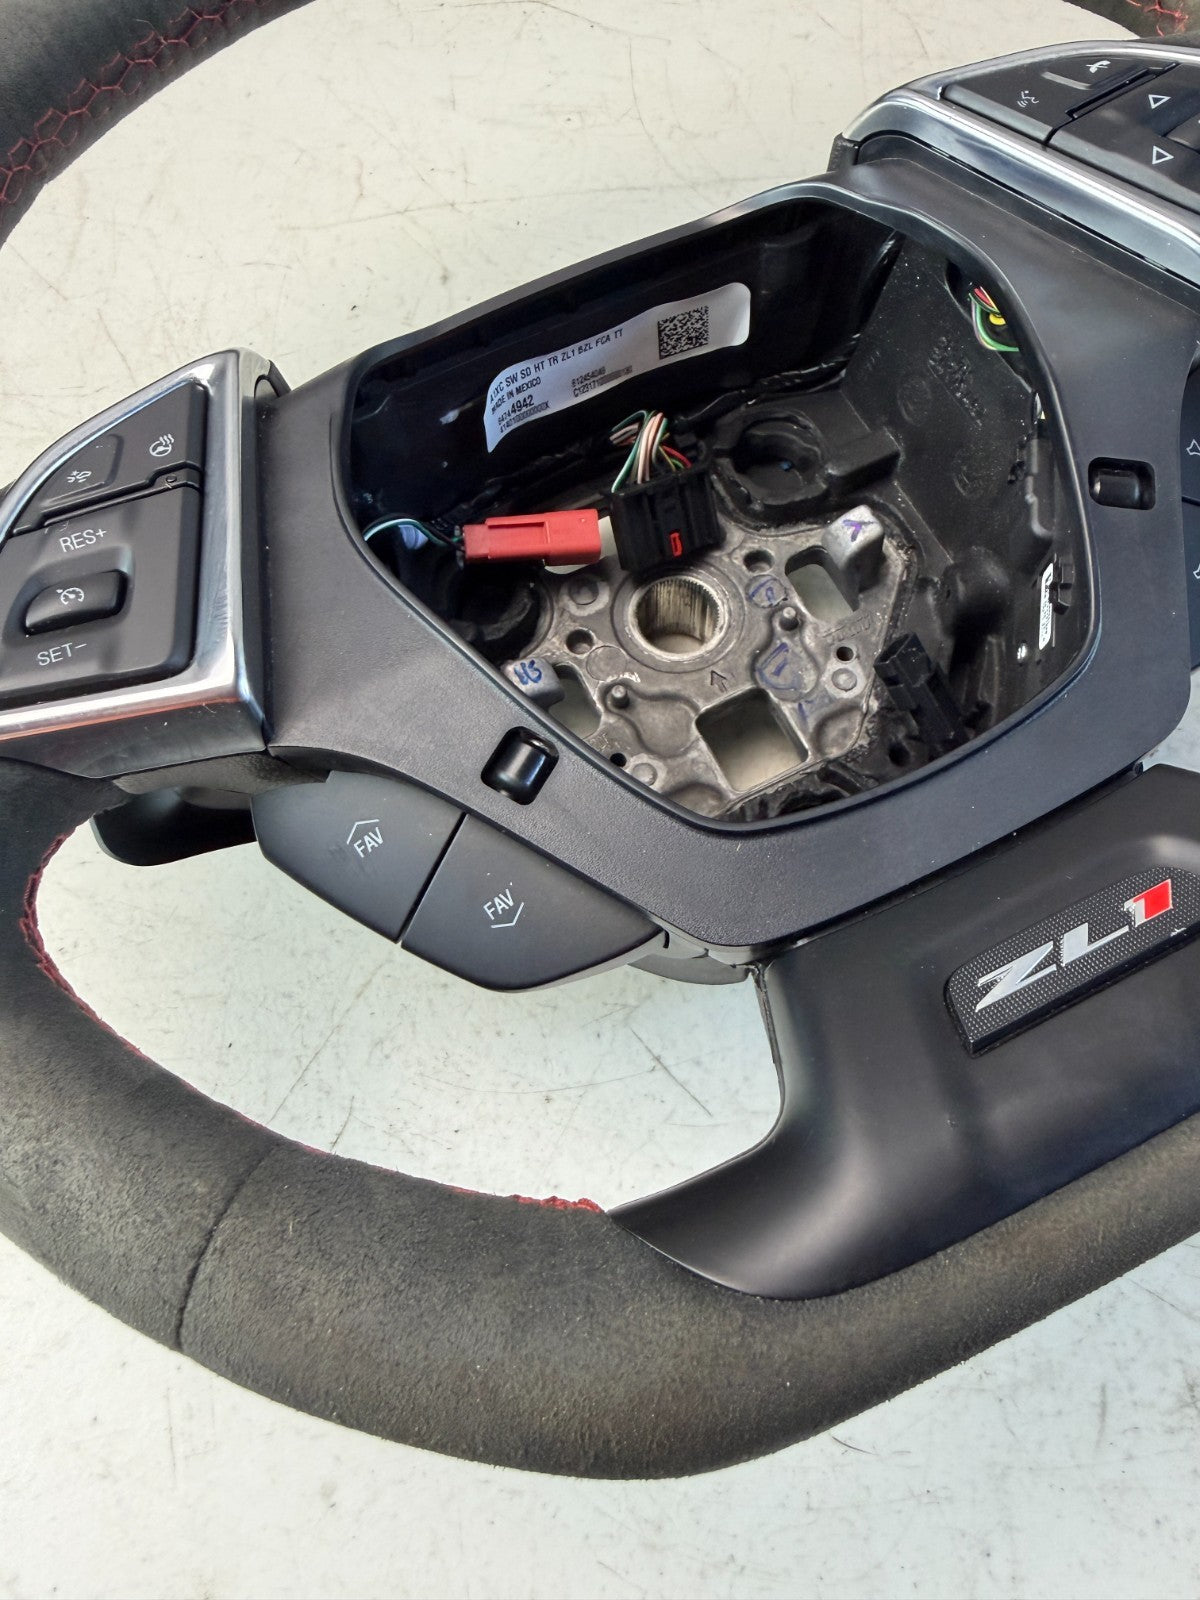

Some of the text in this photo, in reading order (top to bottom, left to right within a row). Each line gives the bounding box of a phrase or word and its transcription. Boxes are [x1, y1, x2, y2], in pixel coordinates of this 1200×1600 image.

[504, 372, 518, 388] SW
[520, 366, 532, 380] SD
[534, 361, 545, 373] HT
[548, 355, 559, 367] TR
[561, 349, 576, 362] ZL1
[578, 343, 594, 355] BZL
[595, 334, 611, 347] FCA
[614, 328, 624, 339] TT
[506, 389, 515, 400] IN
[515, 376, 542, 395] MEXICO
[59, 528, 107, 552] RES+
[353, 827, 384, 858] FAV
[483, 889, 514, 920] FAV
[975, 878, 1173, 1013] ZL1
